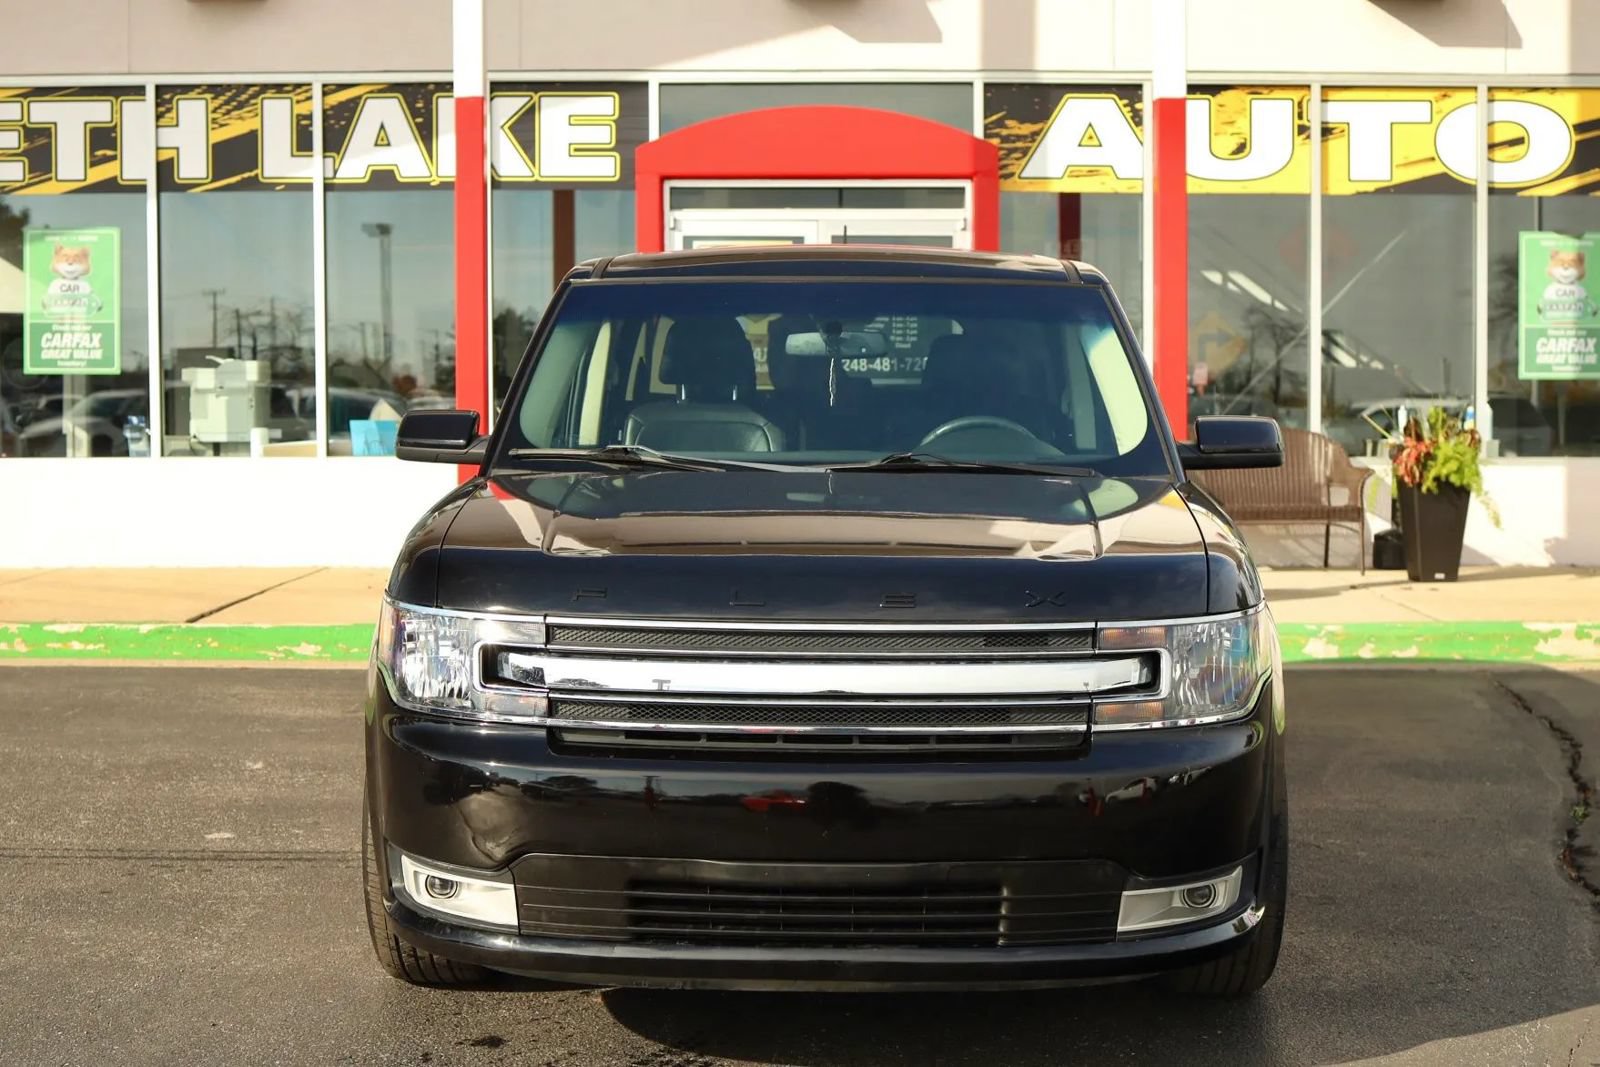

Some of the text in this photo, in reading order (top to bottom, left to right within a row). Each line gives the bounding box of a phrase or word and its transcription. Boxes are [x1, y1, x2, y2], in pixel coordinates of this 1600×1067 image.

[257, 91, 621, 185] LAKE
[1017, 93, 1576, 188] AUTO
[41, 332, 102, 348] CARFAX
[1536, 337, 1597, 352] CARFAX
